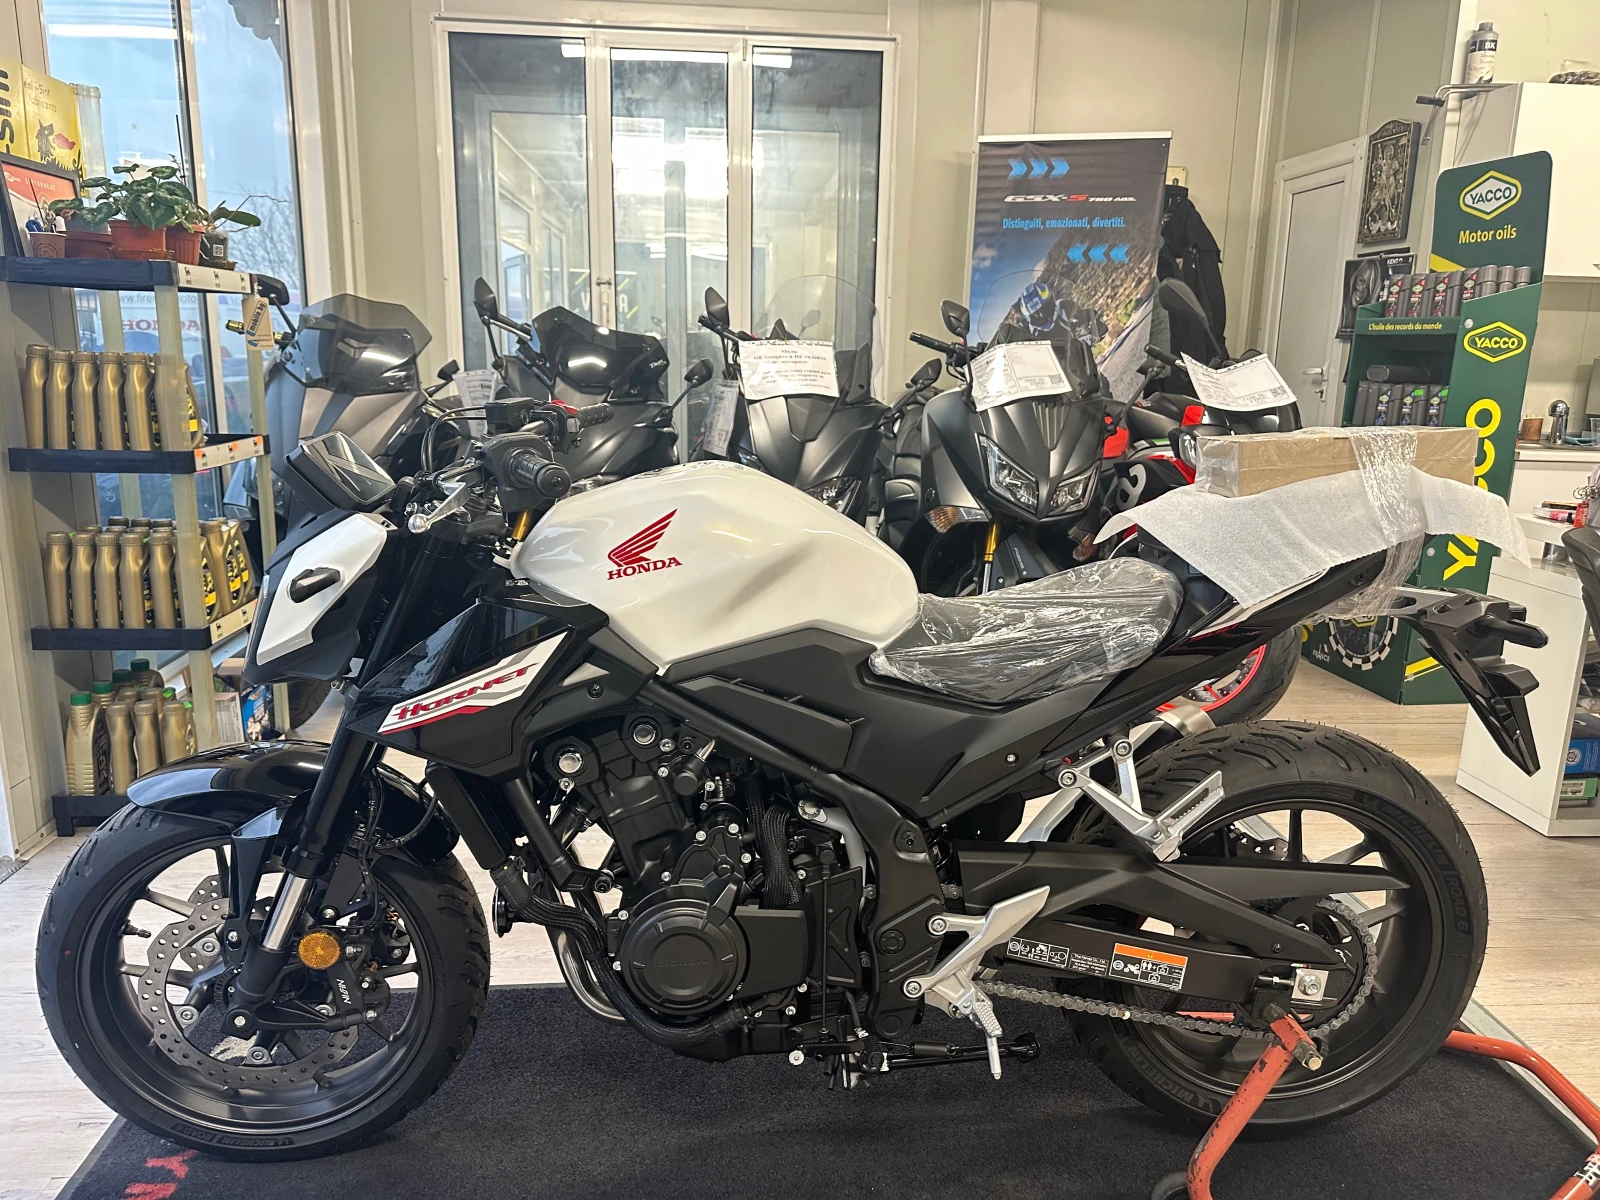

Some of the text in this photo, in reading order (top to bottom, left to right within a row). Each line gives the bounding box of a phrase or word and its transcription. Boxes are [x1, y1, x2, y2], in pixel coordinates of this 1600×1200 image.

[1469, 186, 1512, 205] YACCO
[1002, 216, 1126, 231] Distinguiti, emozionati, divertiti.
[1458, 224, 1517, 244] Motor oils
[249, 302, 268, 331] mobile.bg
[121, 320, 200, 331] HOA
[1386, 322, 1394, 330] des
[1394, 322, 1414, 330] records
[1414, 322, 1422, 330] du
[1422, 322, 1443, 330] monde
[1474, 336, 1518, 349] YACCO
[606, 556, 683, 581] HONDA
[1312, 648, 1331, 663] FRANCE
[390, 662, 540, 720] HORNET
[1130, 1047, 1195, 1103] MICHELIN
[183, 1127, 213, 1142] ROAD
[222, 1136, 276, 1146] MICHELIN
